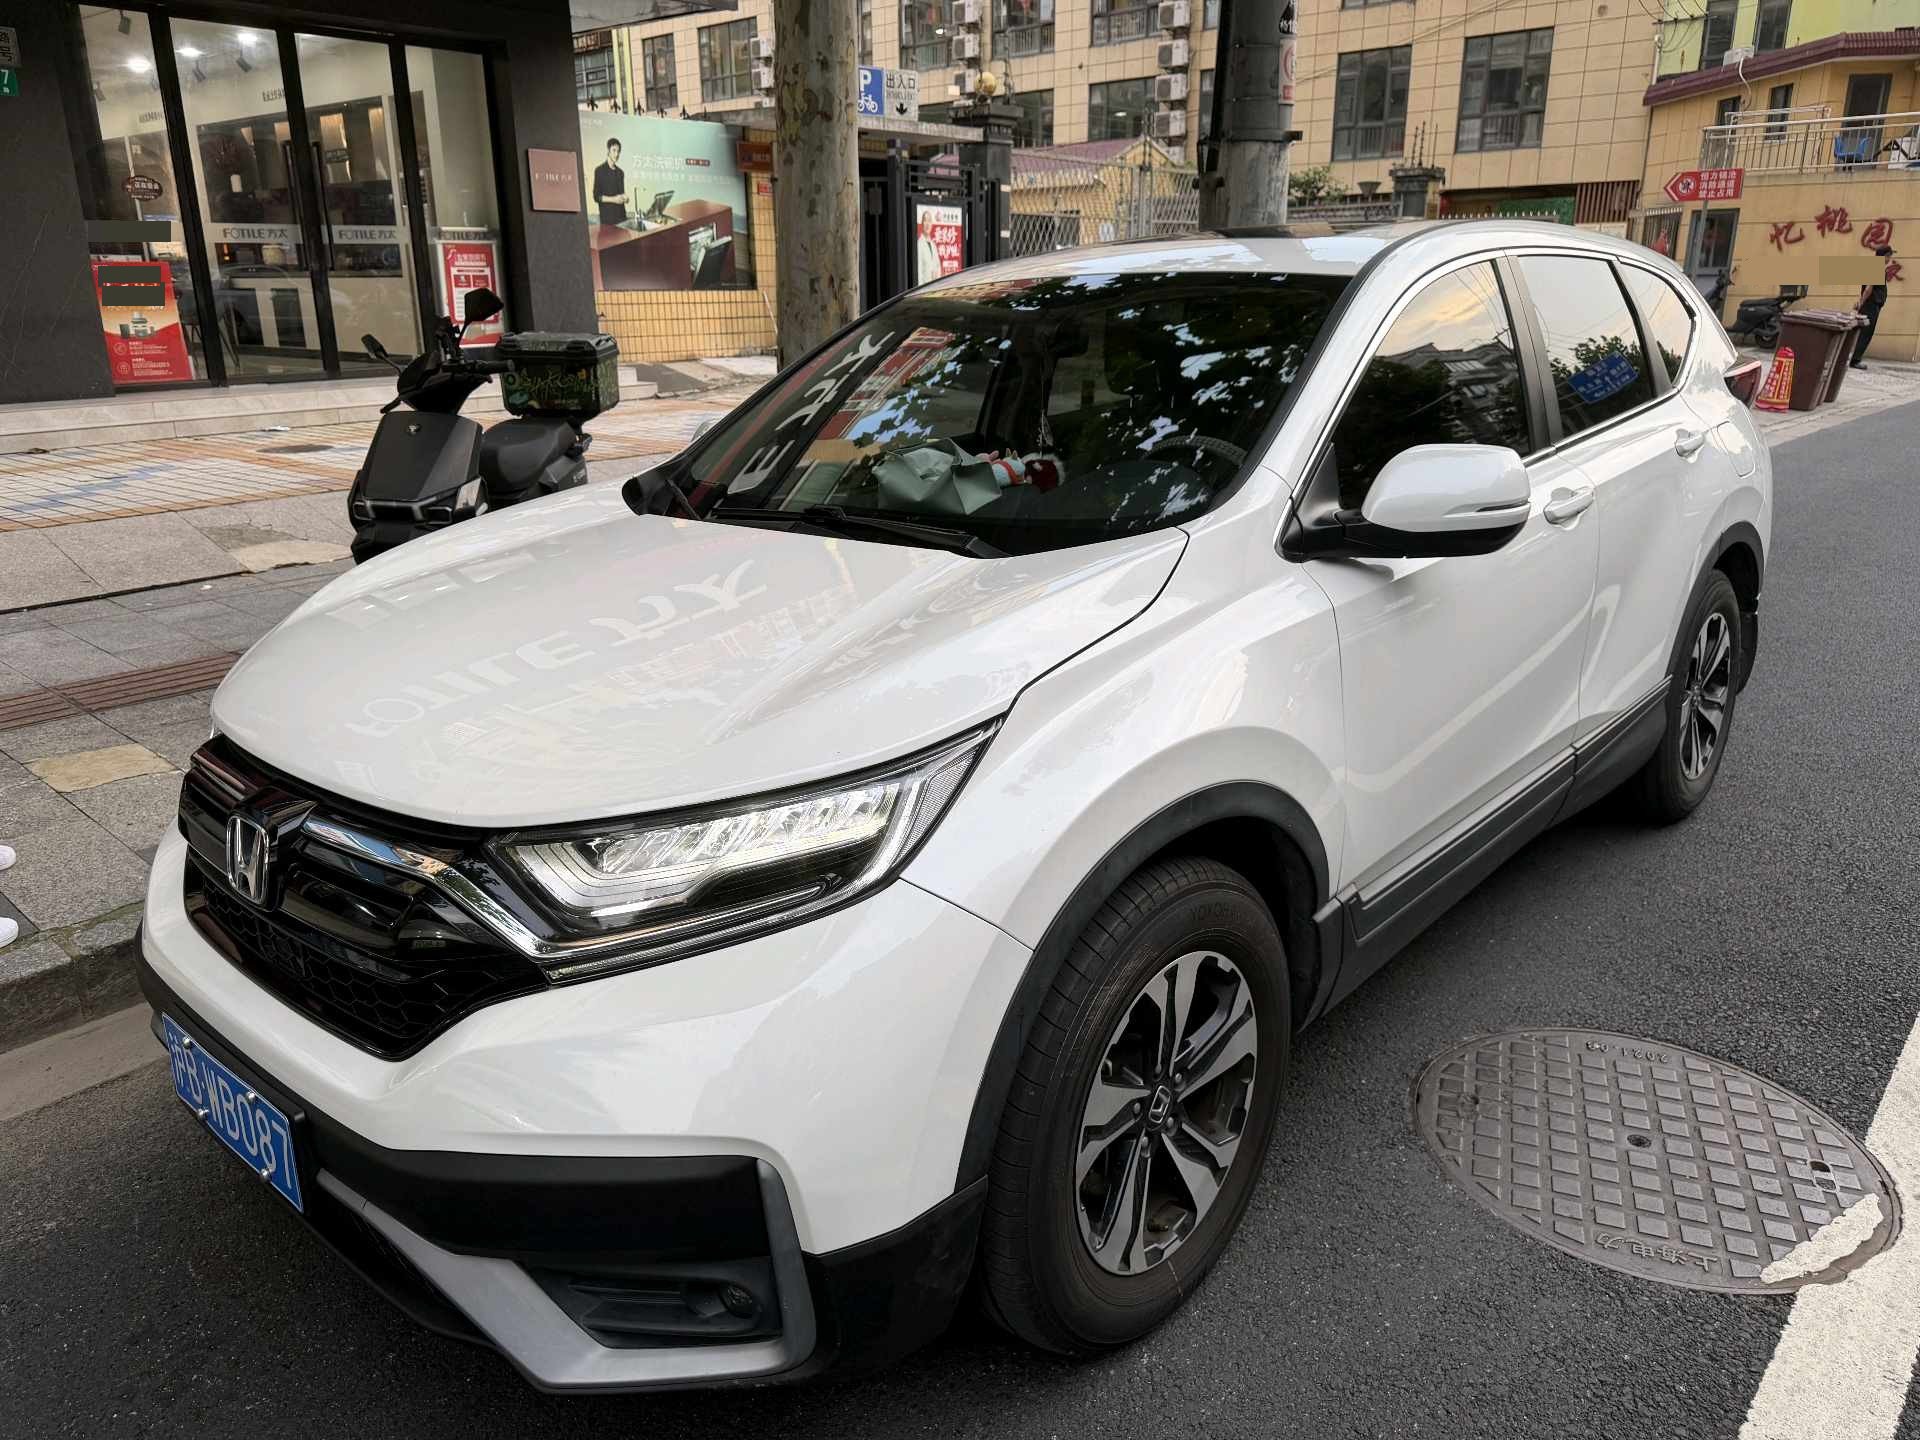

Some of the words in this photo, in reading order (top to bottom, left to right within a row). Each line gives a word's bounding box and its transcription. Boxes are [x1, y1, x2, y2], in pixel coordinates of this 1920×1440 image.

[859, 69, 872, 92] P
[886, 72, 915, 89] 出入口
[1699, 180, 1735, 190] 消防通道
[1699, 189, 1734, 198] 禁止占用
[223, 227, 266, 240] FOTILE
[267, 228, 288, 240] 方太
[338, 229, 377, 240] FOTILE
[378, 230, 397, 240] 方太
[1596, 1232, 1718, 1272] 上海电力
